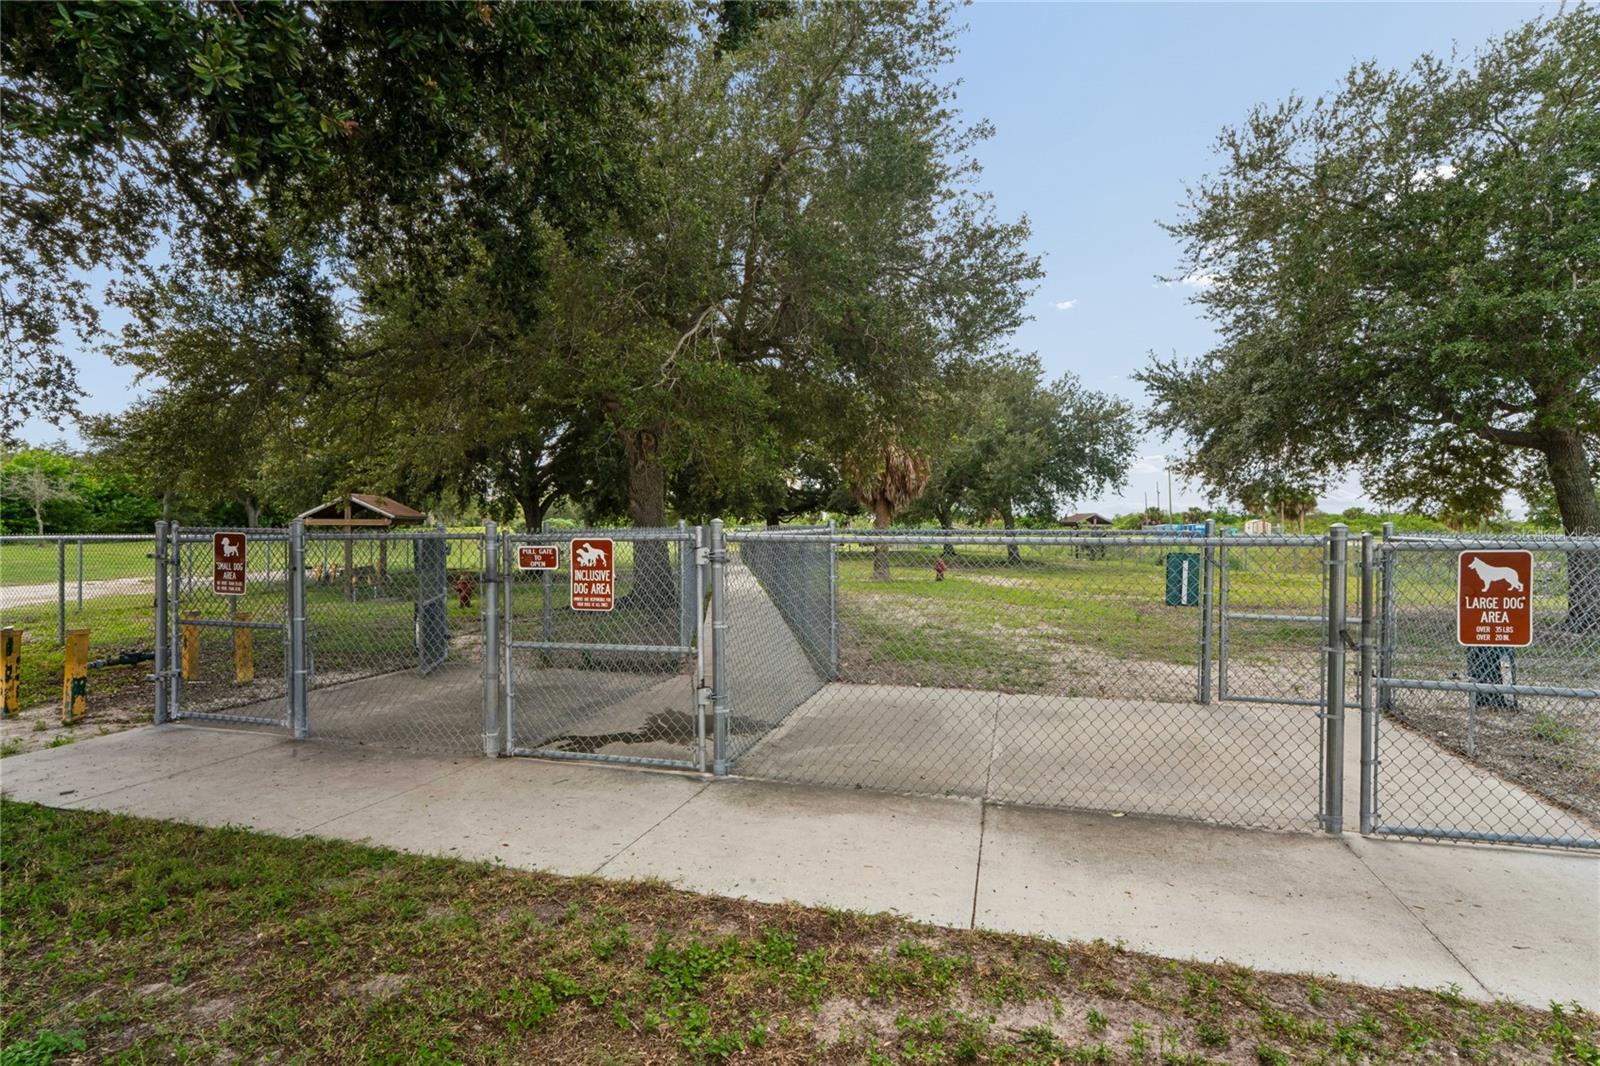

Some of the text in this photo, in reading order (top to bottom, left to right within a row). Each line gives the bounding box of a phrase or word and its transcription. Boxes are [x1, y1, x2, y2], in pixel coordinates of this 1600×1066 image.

[217, 562, 243, 571] SMALL DOG
[223, 571, 237, 580] AREA
[574, 570, 611, 582] INCLUSIVE
[573, 582, 611, 595] DOG AREA
[1466, 596, 1524, 609] LARGE DOG
[1480, 611, 1510, 623] AREA
